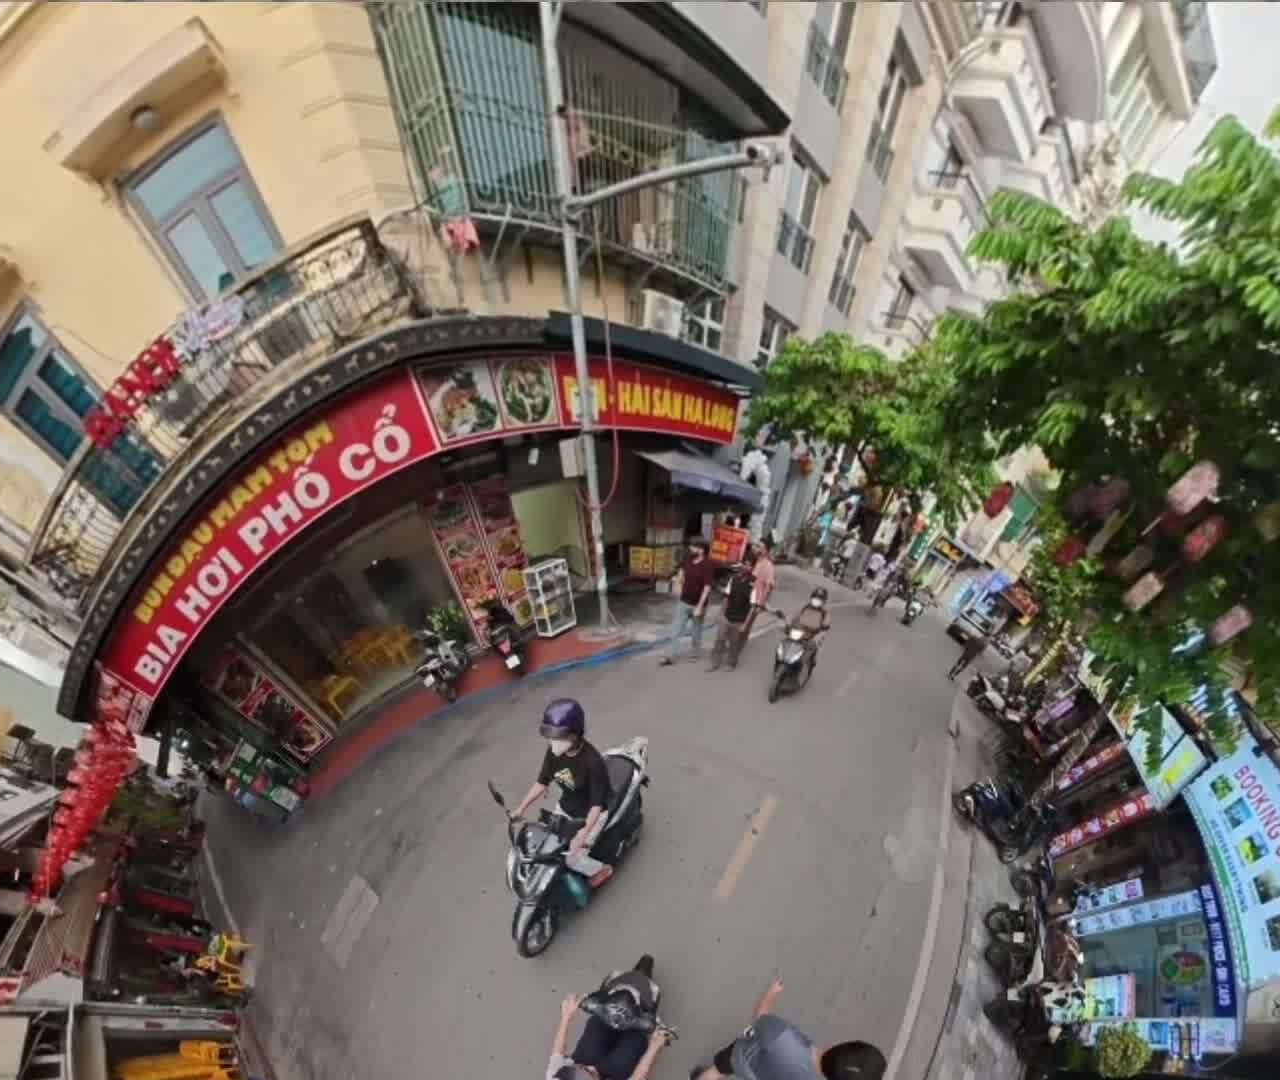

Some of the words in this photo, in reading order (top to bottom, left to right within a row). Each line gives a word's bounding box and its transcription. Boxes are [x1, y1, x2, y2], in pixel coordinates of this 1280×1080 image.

[133, 622, 189, 685] BIA
[173, 546, 245, 624] HƠI
[237, 453, 331, 554] PHỐ
[338, 403, 412, 482] CỔ
